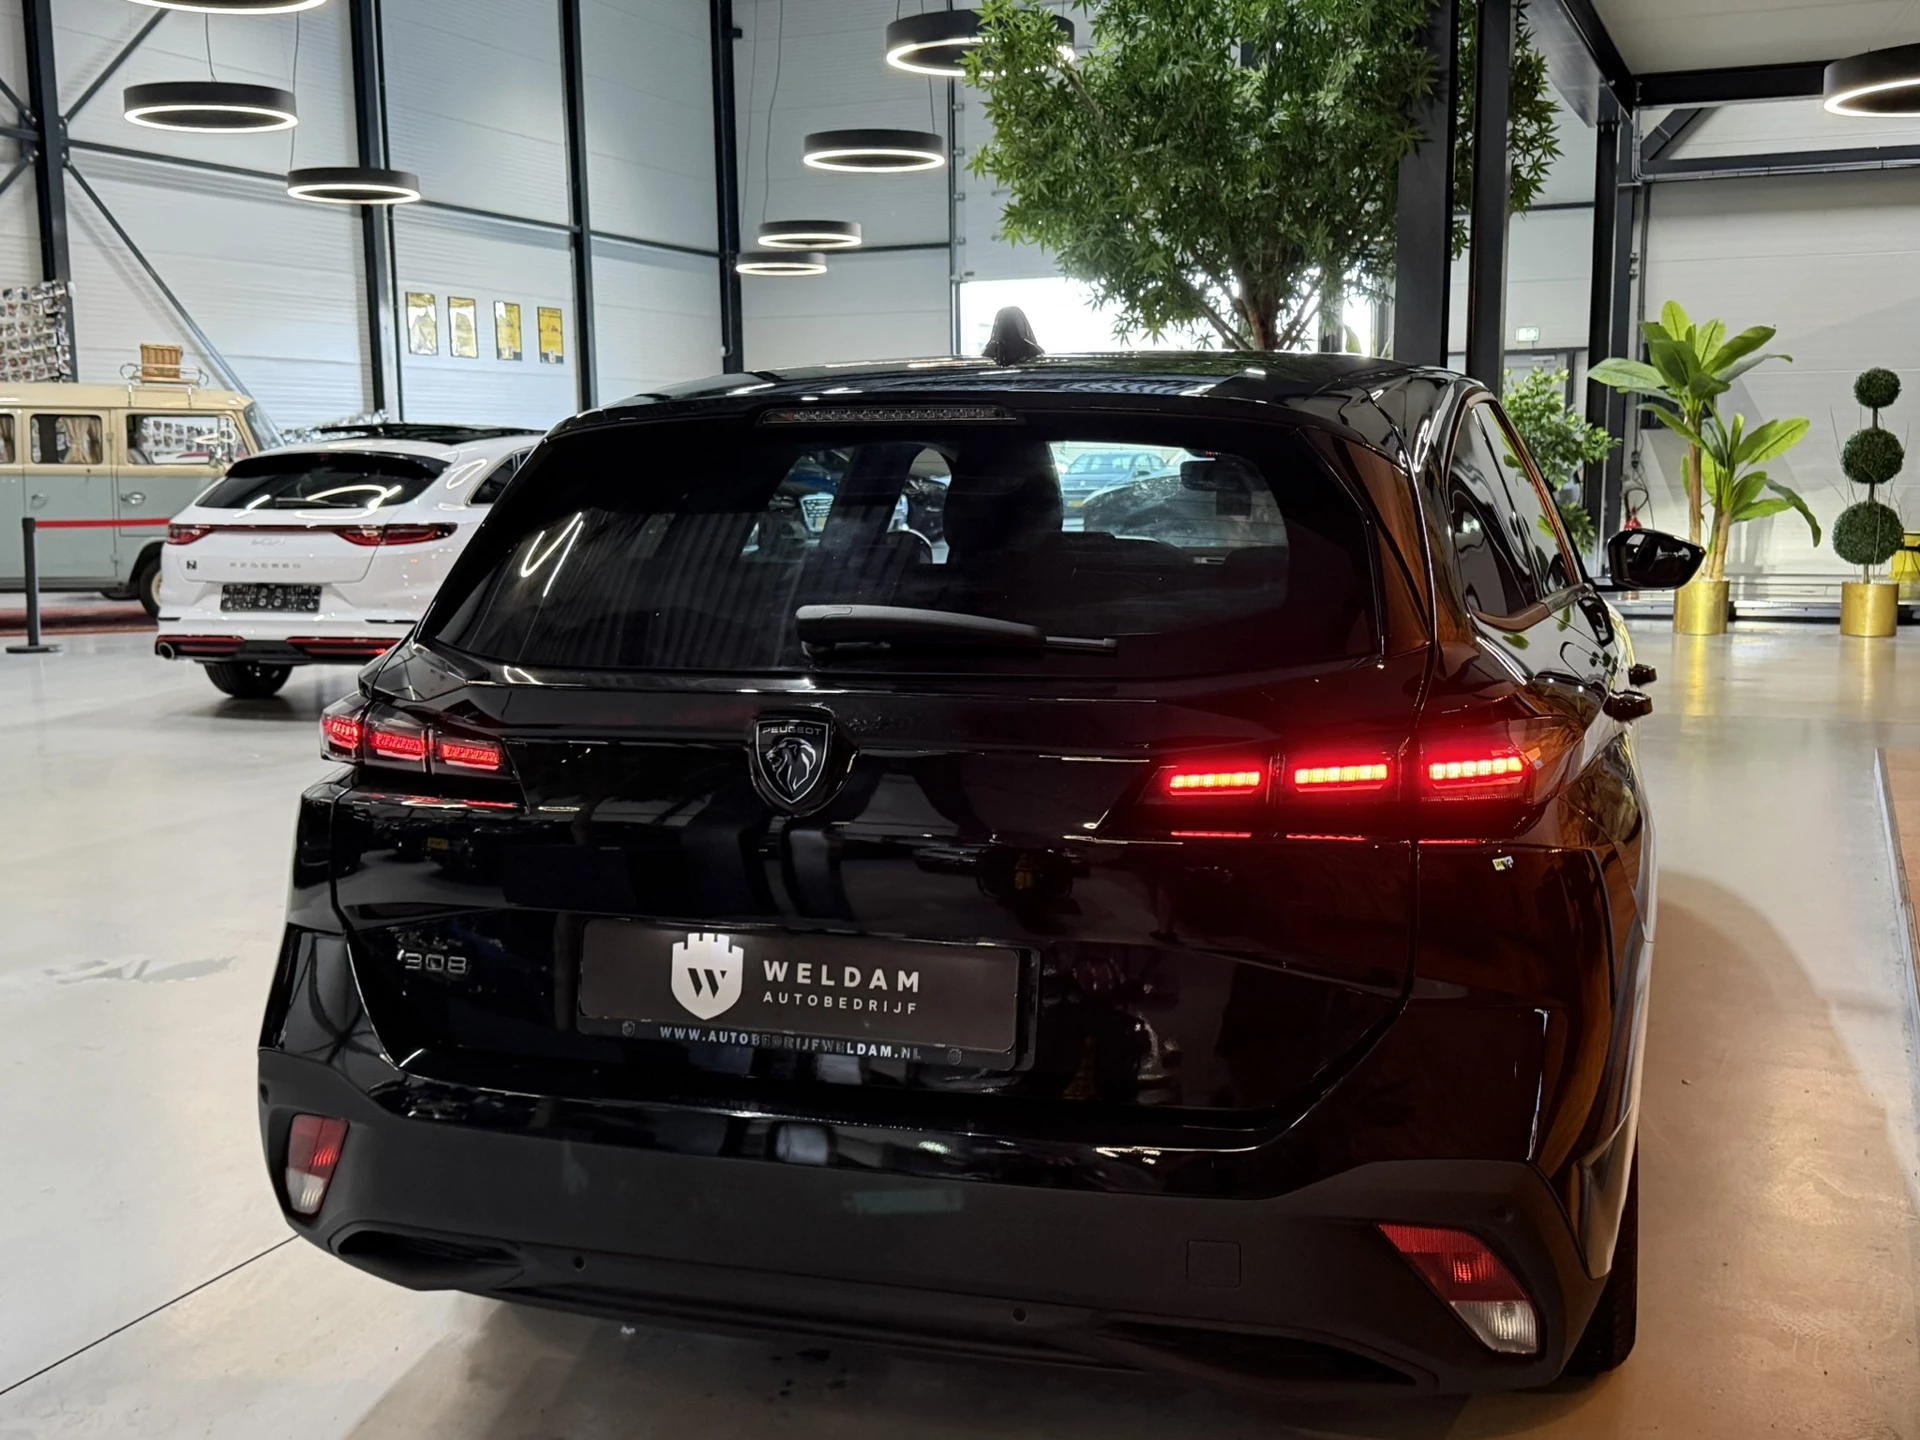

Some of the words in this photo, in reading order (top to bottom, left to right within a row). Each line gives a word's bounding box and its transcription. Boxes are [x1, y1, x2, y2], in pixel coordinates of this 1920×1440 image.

[762, 725, 822, 735] PEUGEOT
[404, 952, 467, 974] 308
[762, 960, 920, 993] WELDAM
[687, 967, 728, 999] W
[763, 991, 917, 1015] AUTOBEDRIJF
[659, 1026, 922, 1060] WWW.AUTOBEDRIJFWELDAM.NL
